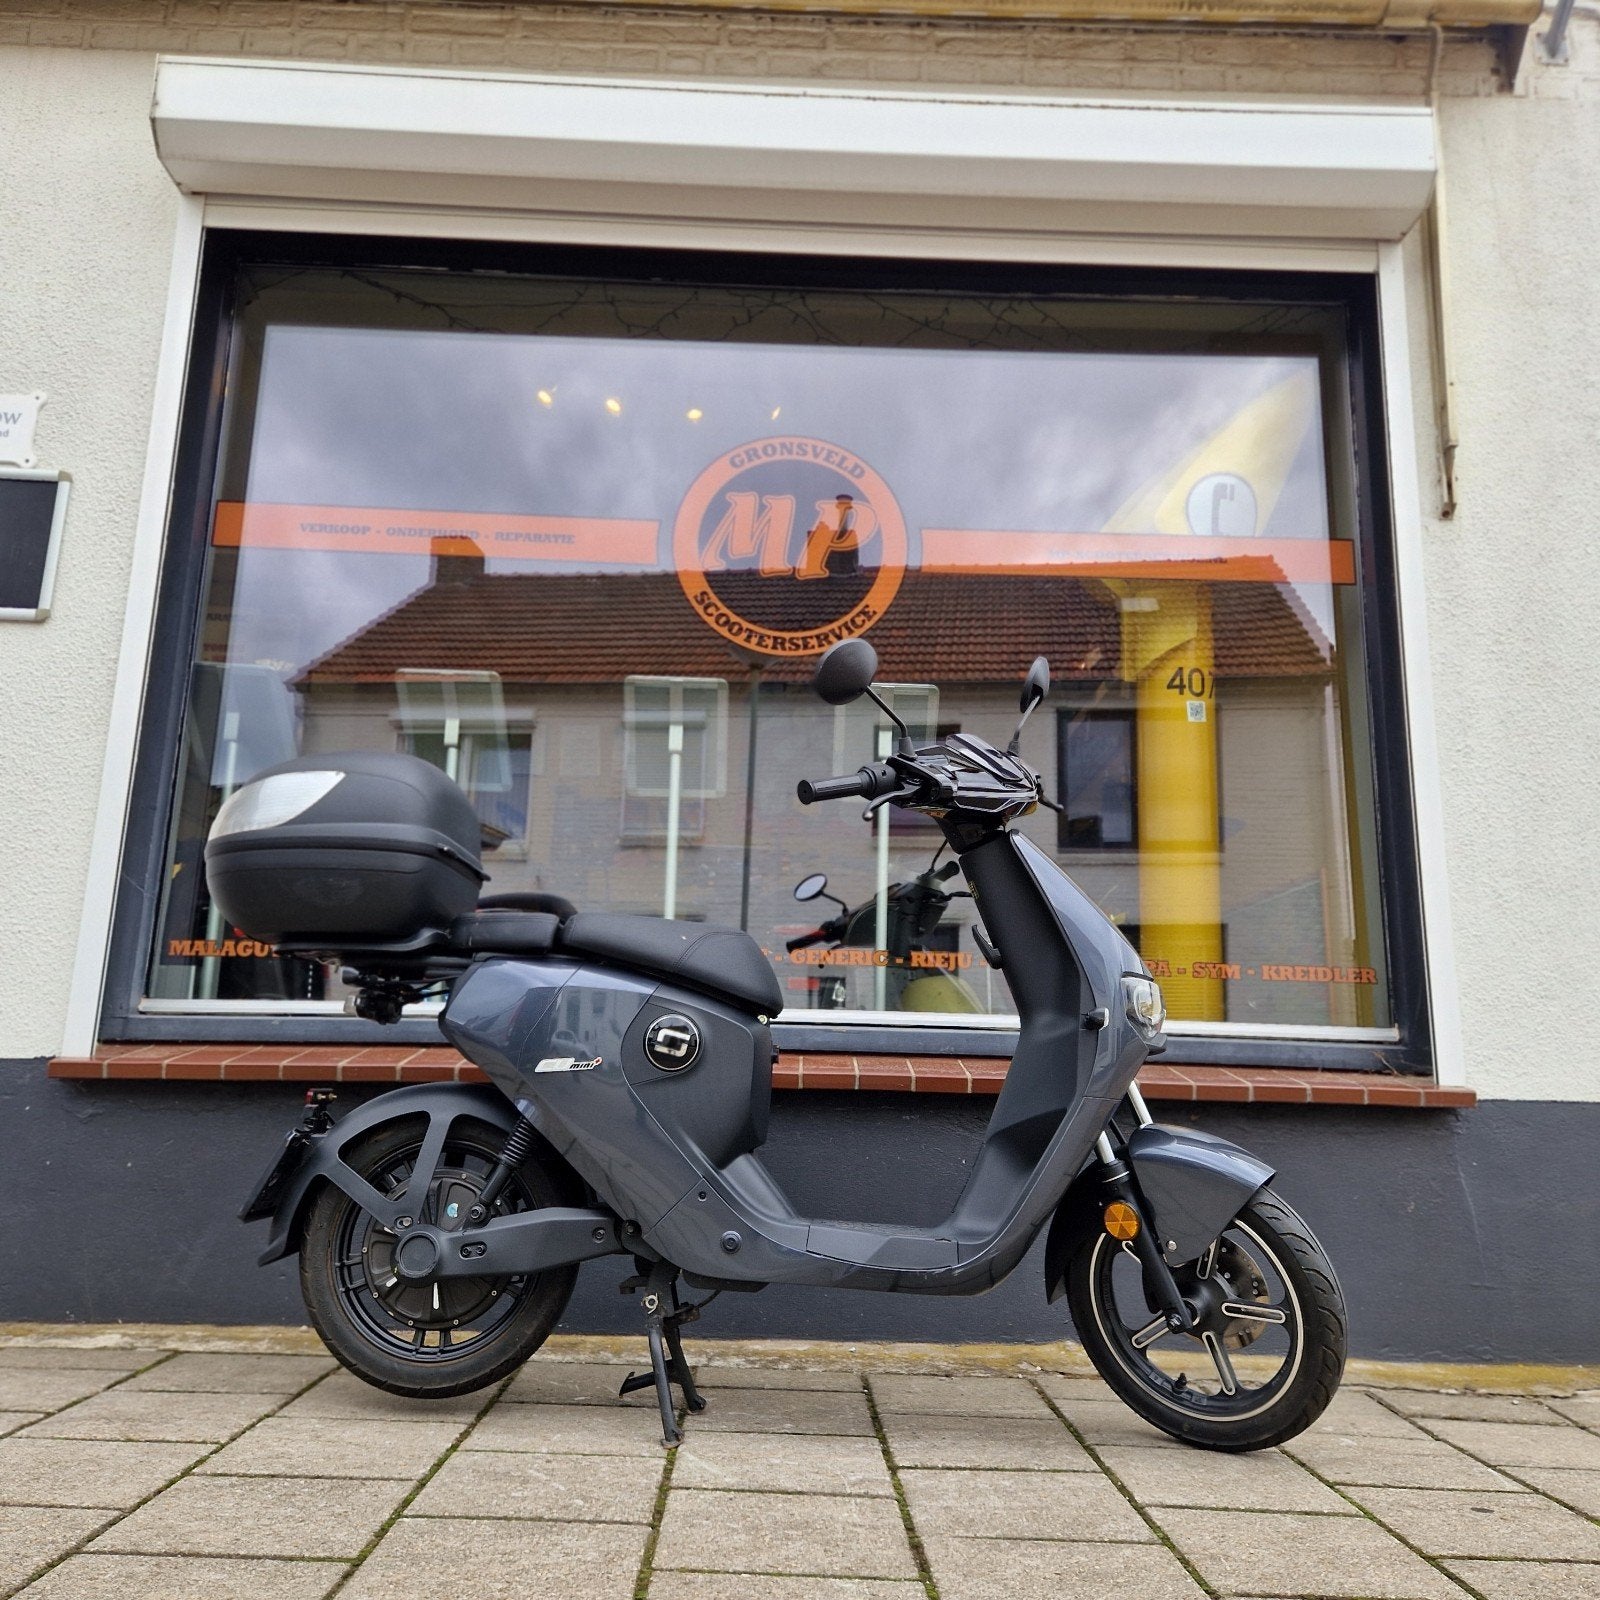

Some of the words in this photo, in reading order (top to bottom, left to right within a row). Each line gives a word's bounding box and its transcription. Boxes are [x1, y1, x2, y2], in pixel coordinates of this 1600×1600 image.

[729, 441, 866, 480] GRONSVELD
[300, 522, 371, 536] VERKOOP
[386, 527, 480, 540] ONDERHOUD
[495, 531, 576, 545] REPARATIE
[701, 491, 878, 580] MP
[693, 589, 878, 652] SCOOTERSERVICE
[791, 950, 889, 967] GENERIC
[910, 951, 973, 971] RIEJU
[1192, 962, 1241, 980] SYM
[1262, 965, 1378, 985] KREIDLER
